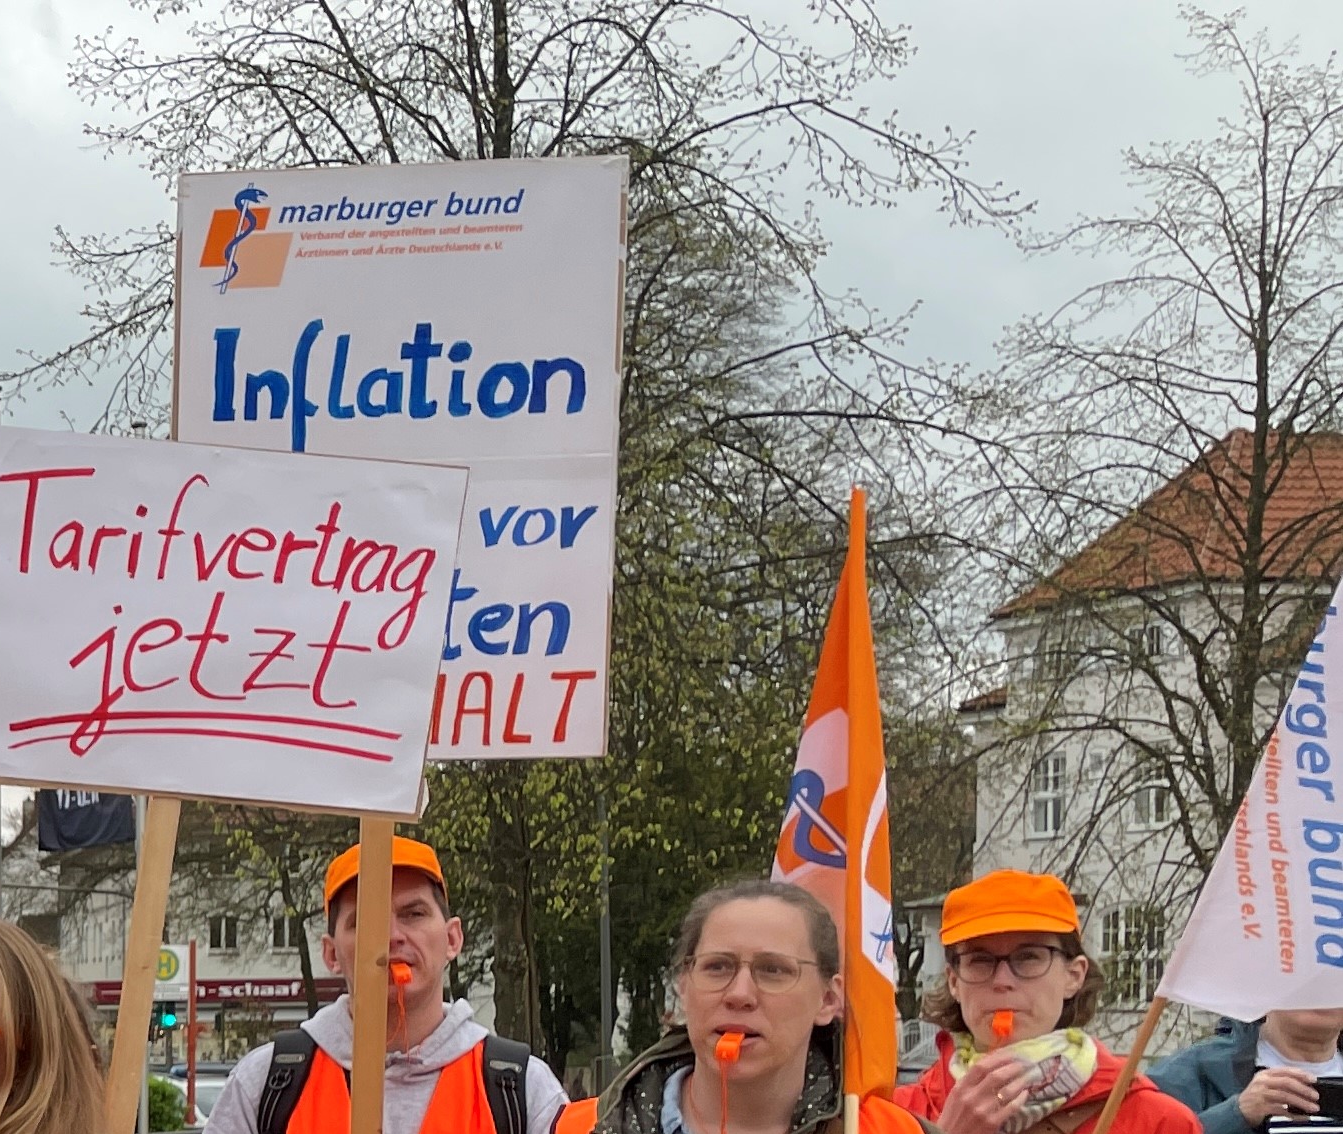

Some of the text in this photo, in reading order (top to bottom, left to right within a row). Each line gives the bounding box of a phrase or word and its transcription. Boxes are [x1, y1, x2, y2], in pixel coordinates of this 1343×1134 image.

[279, 189, 525, 225] marburger bund
[213, 318, 587, 452] Inflation
[479, 504, 599, 550] vor
[69, 591, 373, 757] jetzt
[1272, 859, 1296, 973] beamteten
